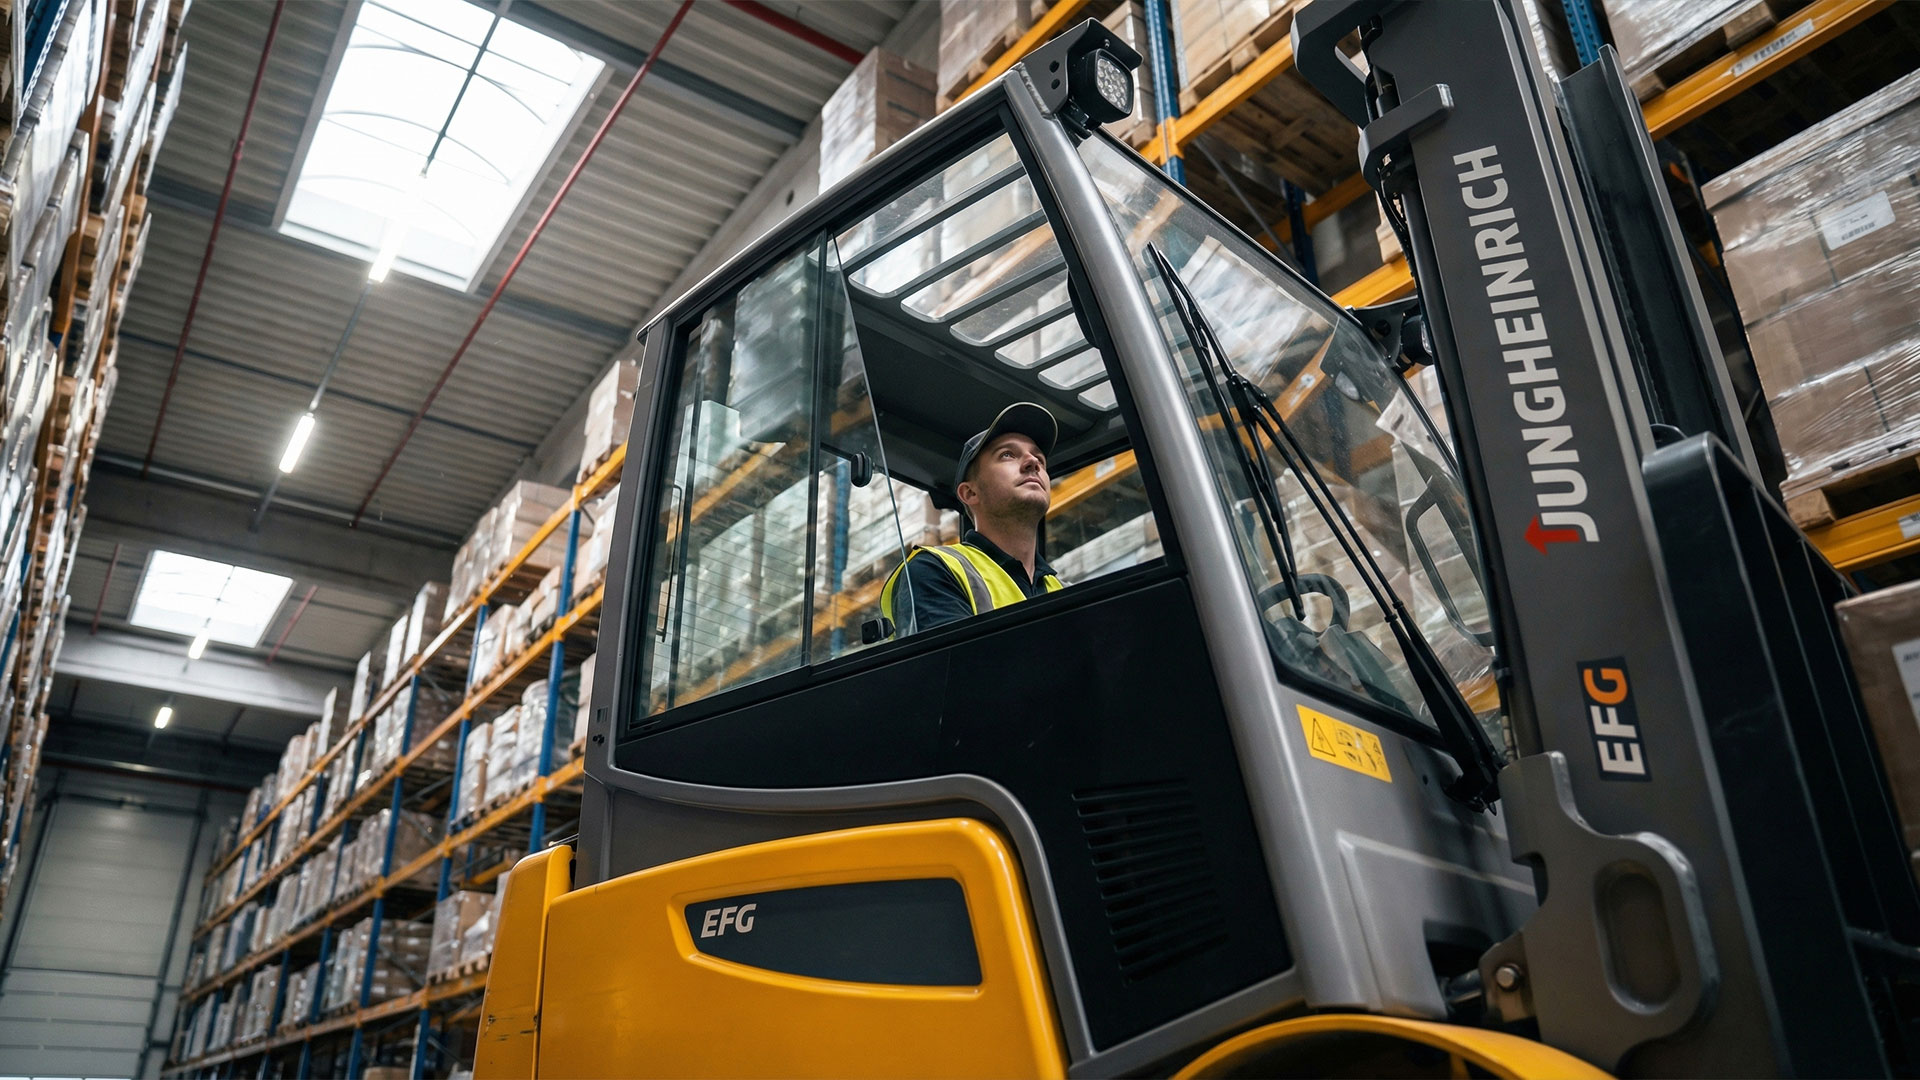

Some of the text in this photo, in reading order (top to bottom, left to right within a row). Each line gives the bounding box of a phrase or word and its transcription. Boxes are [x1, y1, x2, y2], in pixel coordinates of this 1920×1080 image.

[1453, 145, 1600, 542] JUNGHEINRICH
[1583, 668, 1646, 775] EFG
[700, 903, 757, 938] EFG
